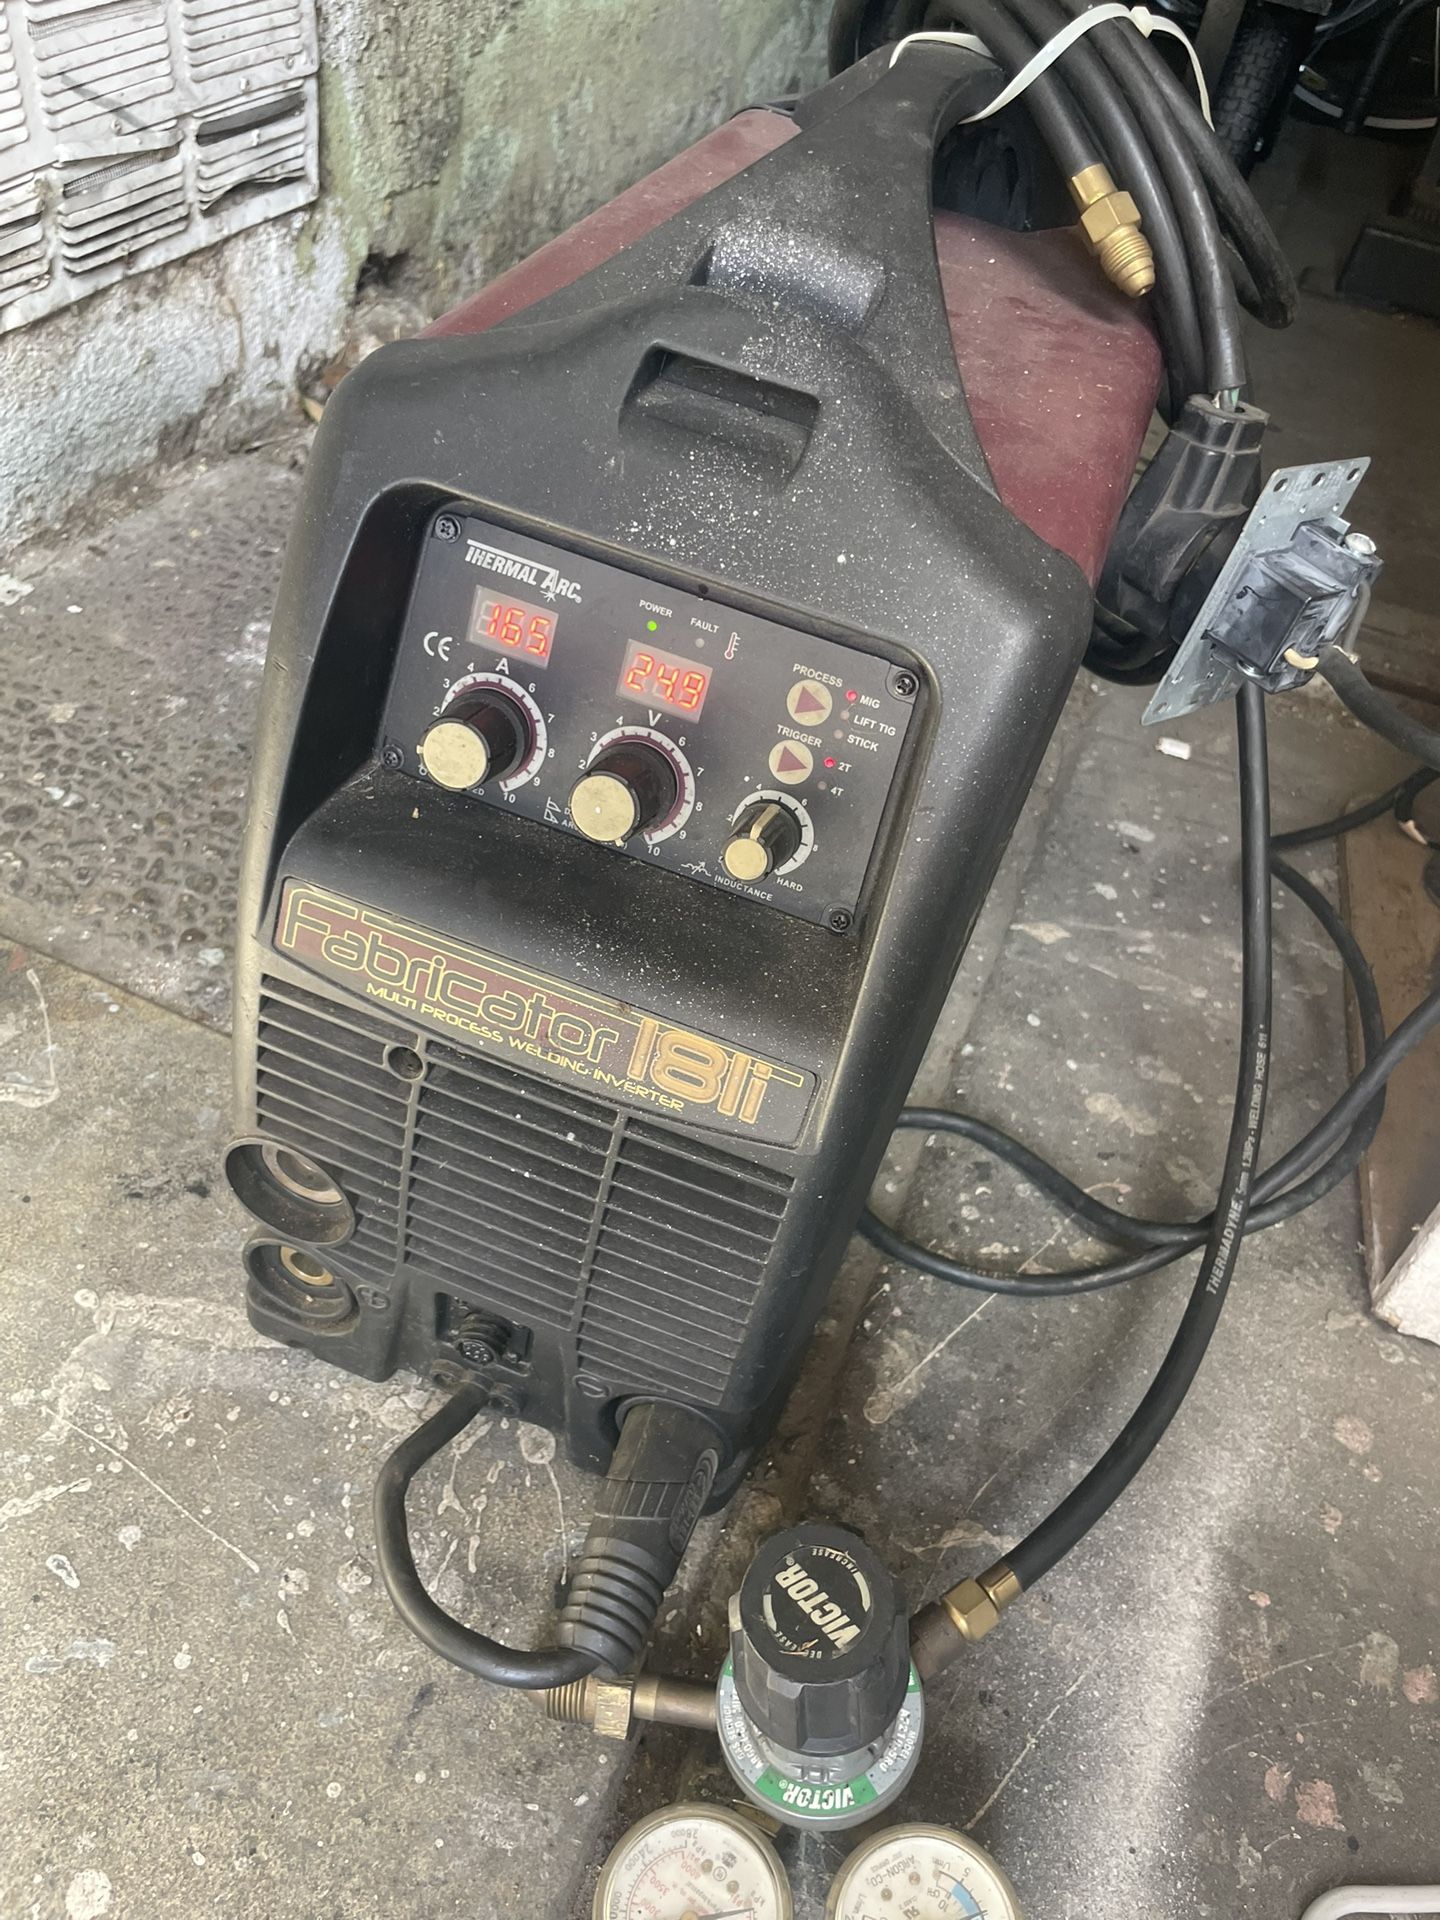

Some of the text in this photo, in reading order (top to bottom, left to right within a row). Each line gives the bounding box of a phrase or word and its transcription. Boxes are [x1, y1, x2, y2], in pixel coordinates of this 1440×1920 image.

[464, 539, 538, 586] THERMAL
[639, 599, 673, 618] POWER
[487, 603, 551, 656] 165
[690, 617, 719, 634] FAULT
[467, 662, 475, 673] 4
[496, 657, 510, 675] A
[624, 653, 706, 711] 24.9
[792, 662, 844, 688] PROCESS
[443, 679, 451, 689] 3
[528, 683, 536, 693] 6
[859, 694, 881, 710] MIG
[433, 706, 441, 717] 2
[547, 713, 556, 723] 7
[648, 709, 662, 727] V
[615, 716, 623, 726] 4
[853, 715, 896, 737] LIFT TIG
[591, 731, 598, 741] 3
[678, 736, 686, 747] 6
[776, 724, 823, 748] TRIGGER
[846, 734, 879, 752] STICK
[547, 748, 556, 759] 8
[578, 759, 586, 770] 2
[697, 767, 704, 777] 7
[838, 761, 852, 774] 2T
[533, 776, 541, 787] 9
[503, 791, 516, 804] 10
[830, 786, 844, 798] 4T
[695, 802, 704, 812] 8
[679, 830, 687, 840] 9
[647, 845, 661, 857] 10
[714, 874, 774, 902] INDUCTANCE
[776, 877, 804, 893] HARD
[282, 888, 624, 1062] Fabricator
[365, 982, 685, 1113] MULTI PROCESS WELDING INVERTER
[1255, 1051, 1267, 1080] HOSE
[1248, 1083, 1263, 1129] WELDING
[811, 1549, 858, 1574] INCREASE
[774, 1631, 822, 1659] DECEASE
[730, 1739, 744, 1760] GAS
